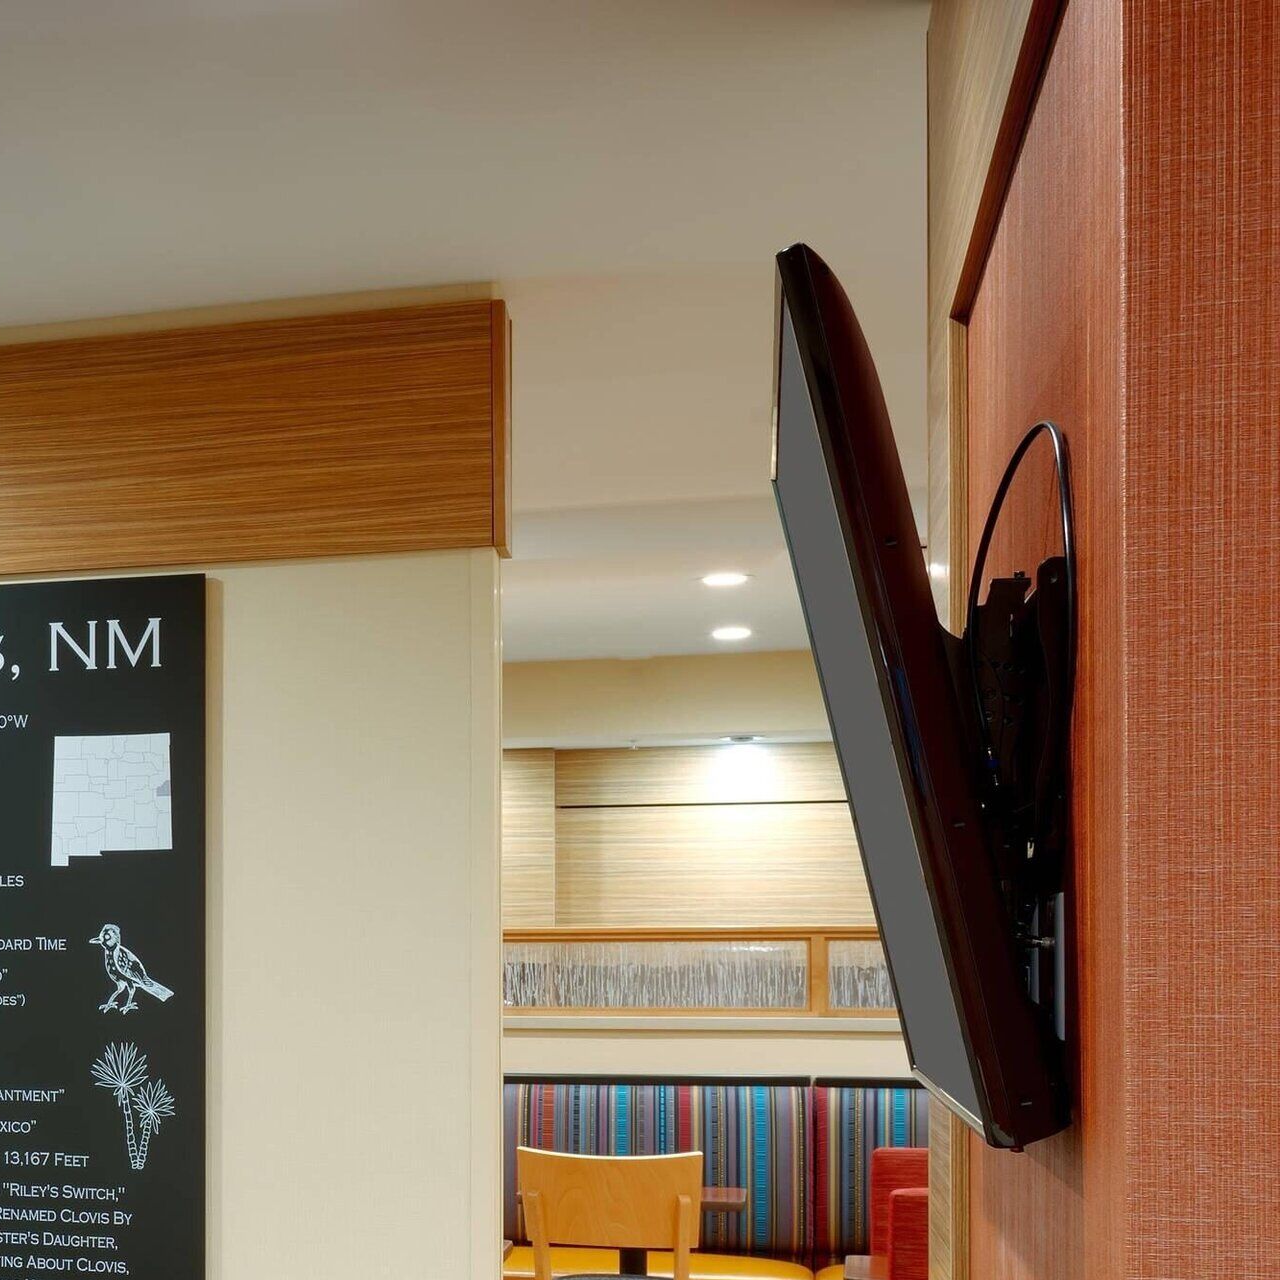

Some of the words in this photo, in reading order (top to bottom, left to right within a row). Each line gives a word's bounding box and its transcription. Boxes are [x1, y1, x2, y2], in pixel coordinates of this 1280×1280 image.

[48, 617, 163, 671] NM
[35, 936, 67, 952] TIME
[4, 1150, 50, 1167] 13,167
[54, 1151, 90, 1168] FEET
